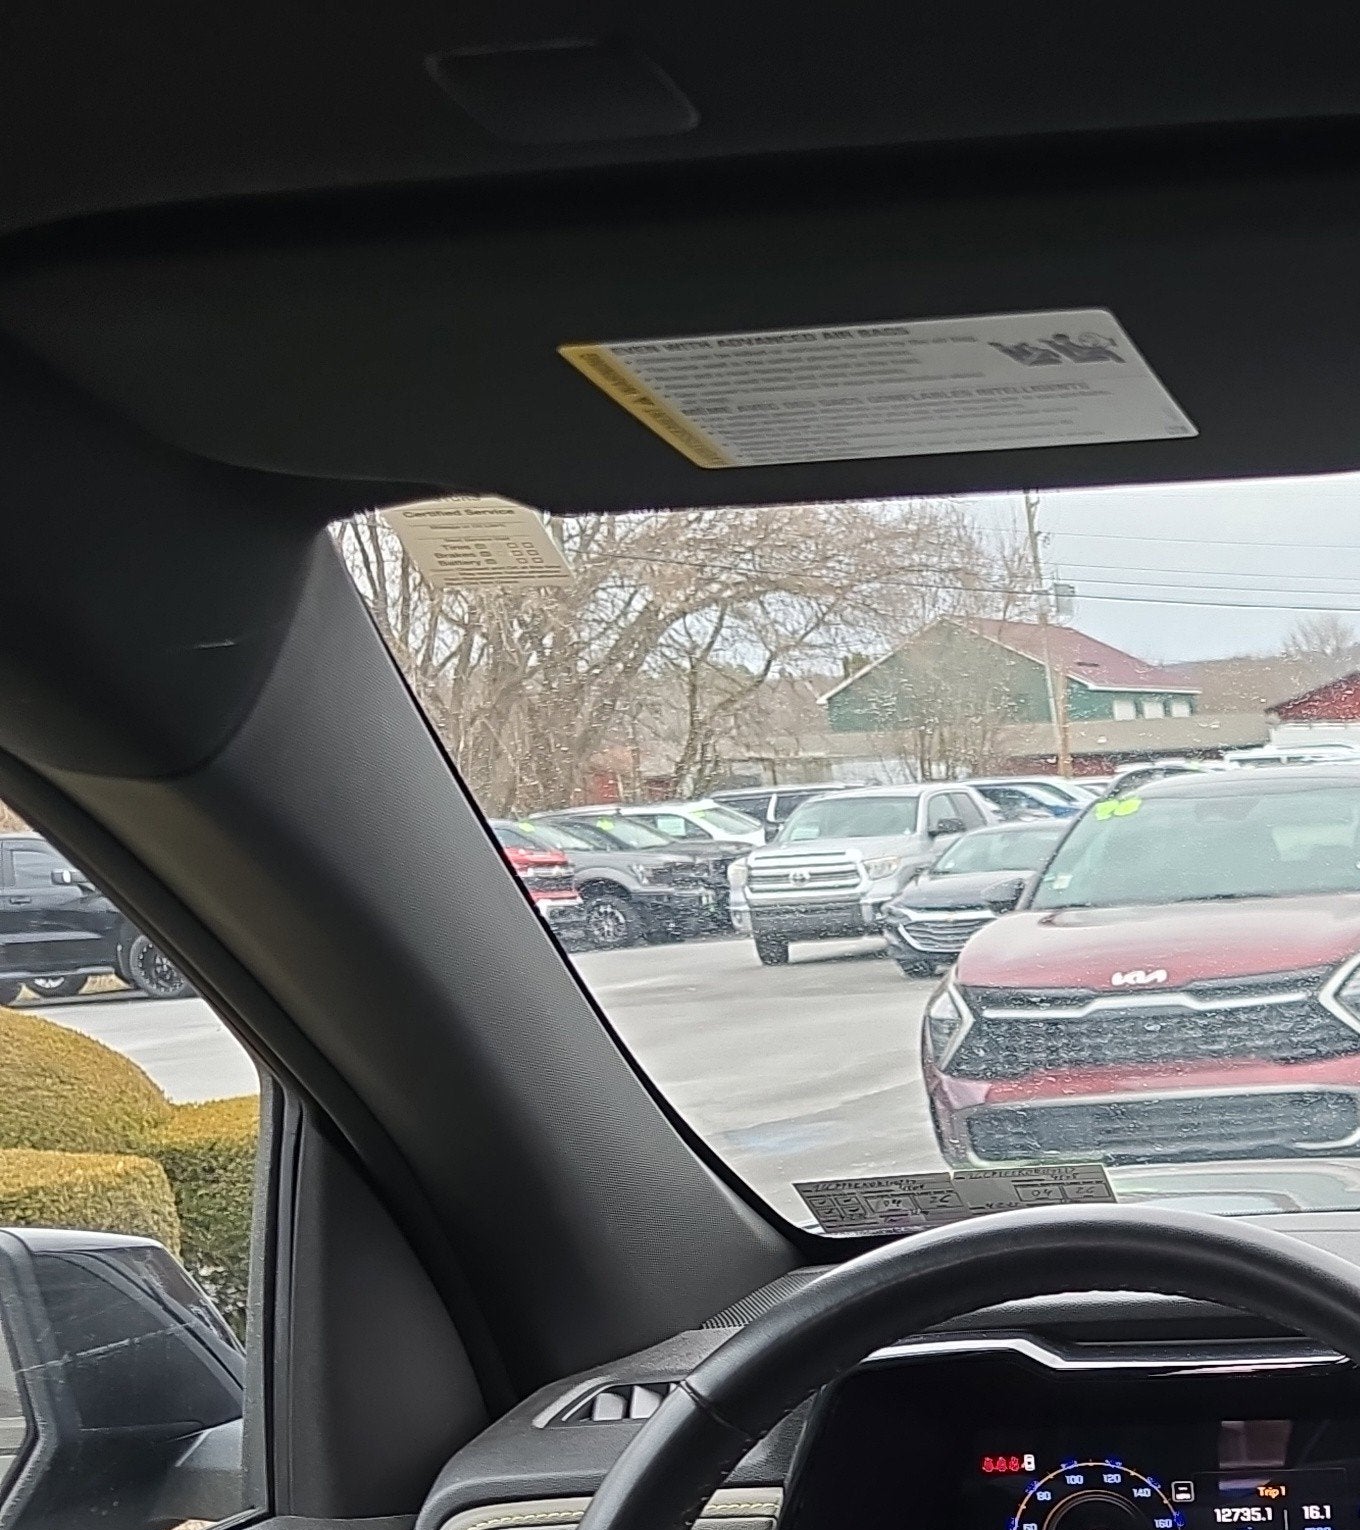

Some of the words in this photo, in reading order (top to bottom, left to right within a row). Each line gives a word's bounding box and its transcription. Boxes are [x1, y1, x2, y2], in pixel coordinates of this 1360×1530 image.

[717, 333, 817, 348] ADVANCED
[821, 330, 853, 340] AIR
[403, 509, 462, 518] Certified
[464, 508, 515, 517] Service
[1065, 1475, 1084, 1485] 100
[1102, 1474, 1121, 1484] 120
[1036, 1491, 1052, 1501] 80
[1132, 1488, 1151, 1498] 140
[1257, 1486, 1279, 1499] Trip
[1214, 1507, 1273, 1523] 12735.1
[1302, 1505, 1331, 1520] 16.1
[1154, 1519, 1172, 1529] 160
